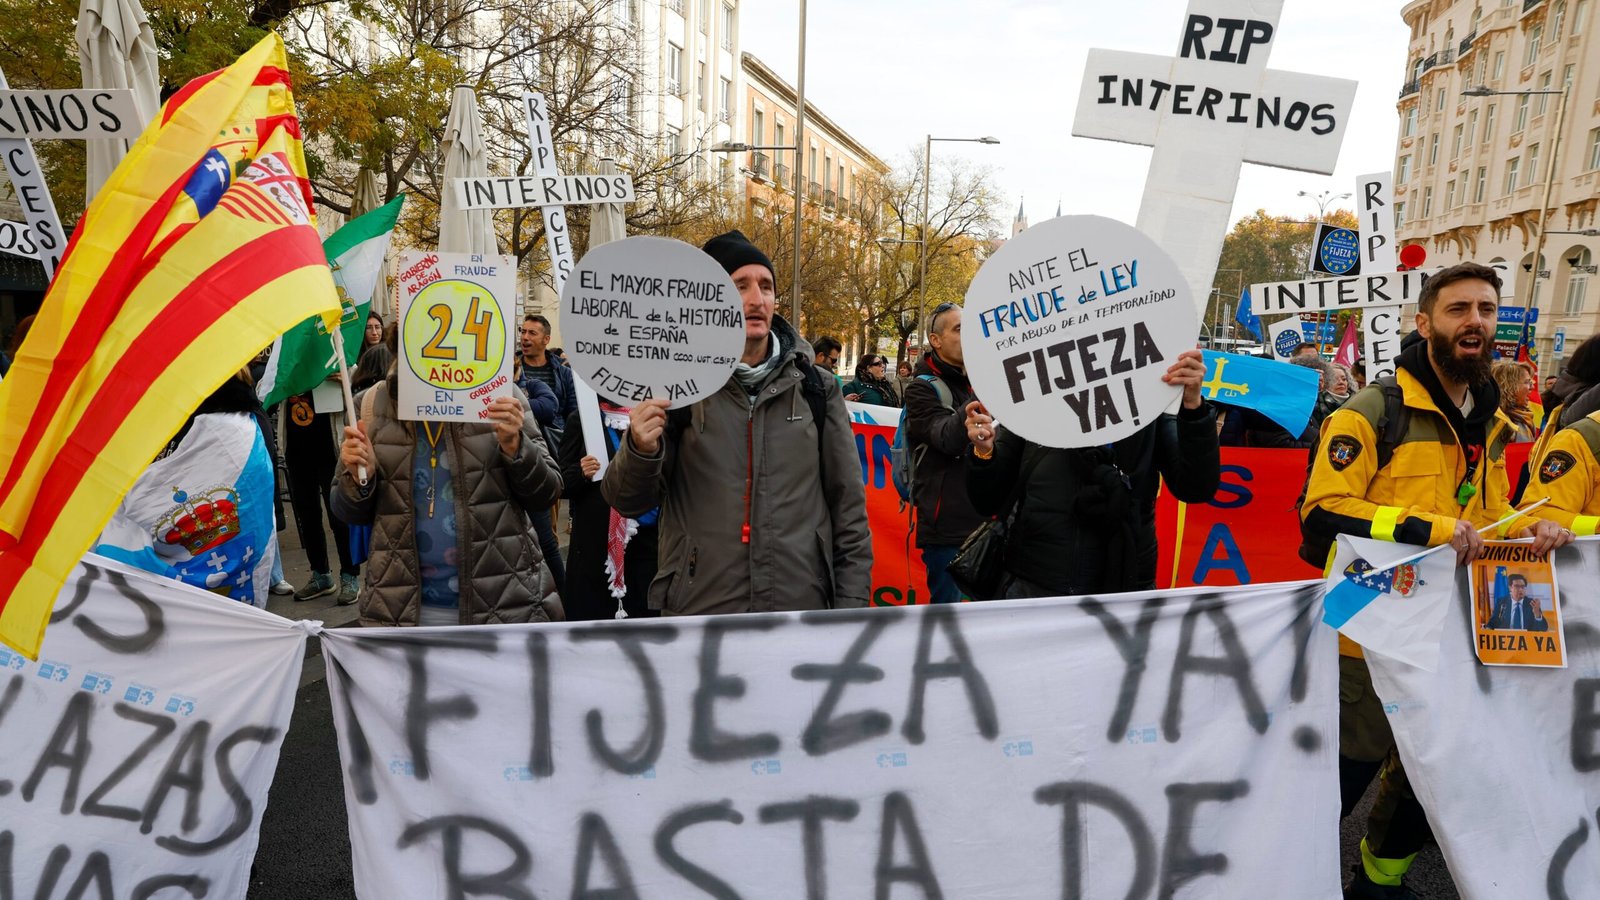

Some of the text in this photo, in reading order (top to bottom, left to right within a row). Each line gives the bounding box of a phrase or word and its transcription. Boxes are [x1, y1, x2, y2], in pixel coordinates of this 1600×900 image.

[1180, 14, 1274, 64] RIP
[1097, 75, 1336, 135] INTERINOS
[528, 98, 549, 169] RIP
[463, 176, 628, 207] INTERINOS
[1364, 181, 1386, 262] RIP
[400, 254, 439, 282] GOBIERNO
[471, 254, 483, 263] EN
[1329, 246, 1351, 259] FIJEZA
[454, 265, 497, 277] FRAUDE
[1008, 248, 1098, 293] ANTE EL
[580, 270, 725, 303] EL MAYOR FRAUDE
[979, 259, 1139, 338] FRAUDE de LEY
[571, 296, 639, 320] LABORAL
[646, 308, 662, 322] de
[665, 310, 677, 323] la
[422, 296, 493, 362] 24
[604, 323, 689, 345] de ESPAÑA
[995, 336, 1018, 351] POR
[1021, 324, 1057, 342] ABUSO
[1061, 316, 1076, 329] DE
[1078, 313, 1090, 324] LA
[575, 341, 621, 357] DONDE
[627, 345, 670, 360] ESTAN
[1002, 321, 1165, 404] FIJEZA
[429, 364, 475, 384] AÑOS
[469, 375, 508, 400] GOBIERNO
[591, 367, 700, 402] FIJEZA YA!!
[417, 405, 465, 416] FRAUDE
[435, 391, 454, 403] EN
[1062, 377, 1141, 434] YA!
[1480, 634, 1557, 652] FIJEZA YA
